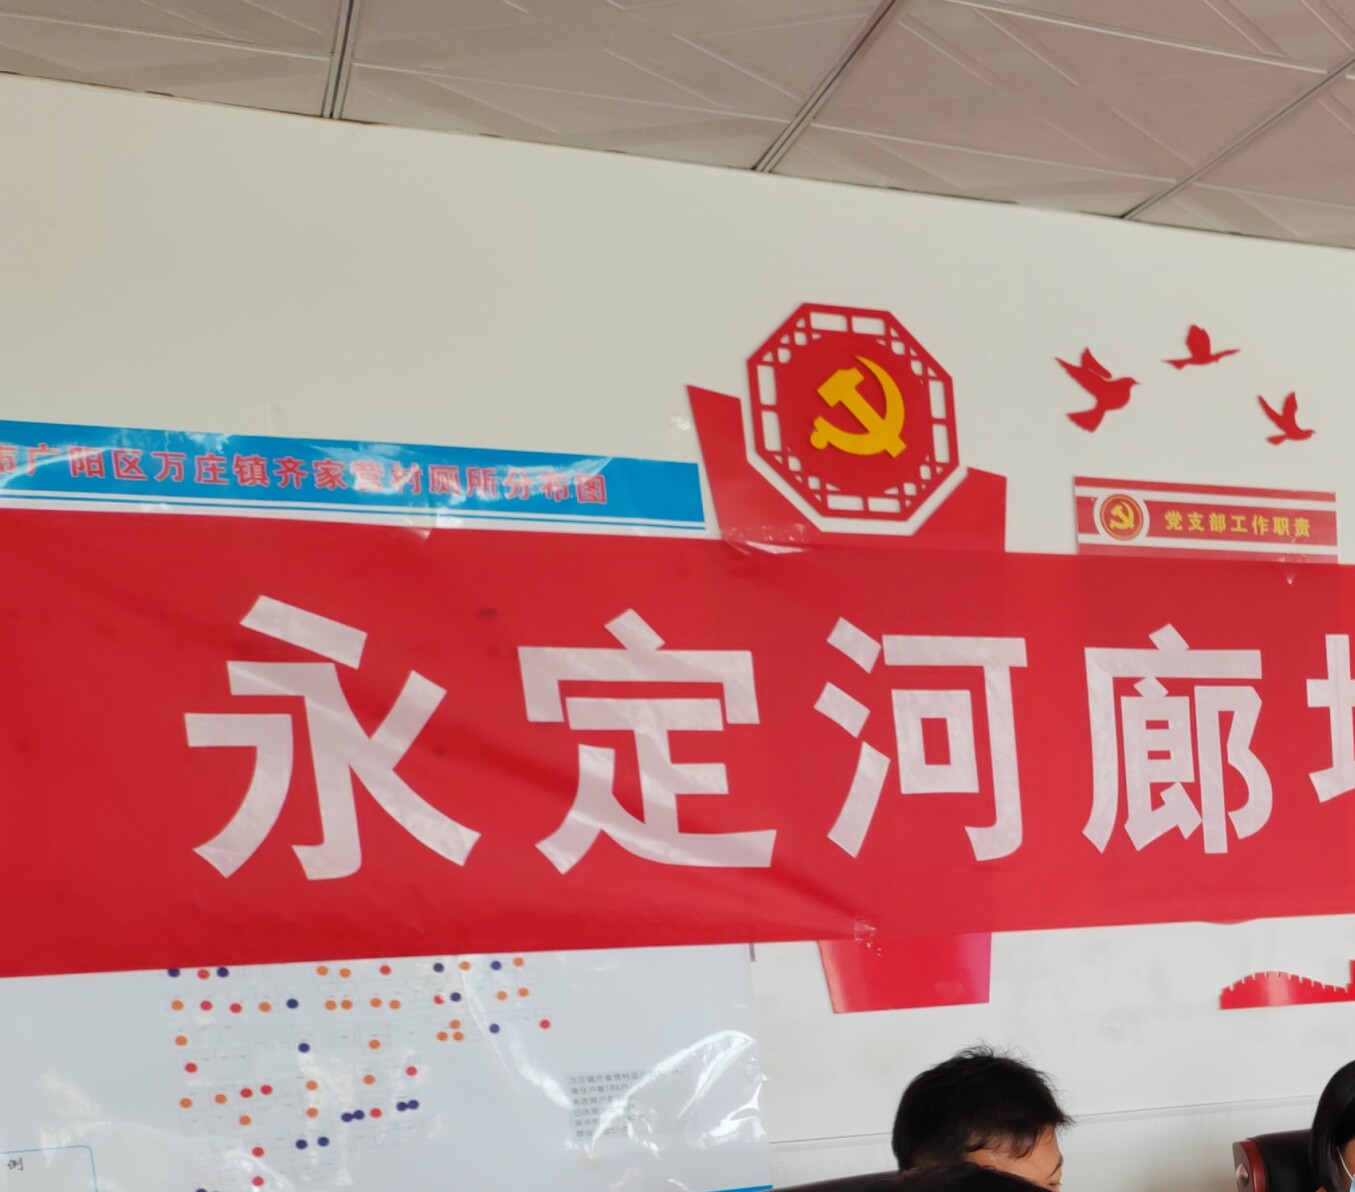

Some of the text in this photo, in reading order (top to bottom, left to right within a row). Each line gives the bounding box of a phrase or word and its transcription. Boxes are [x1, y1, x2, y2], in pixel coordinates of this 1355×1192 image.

[1164, 509, 1311, 537] 党支部工作职责
